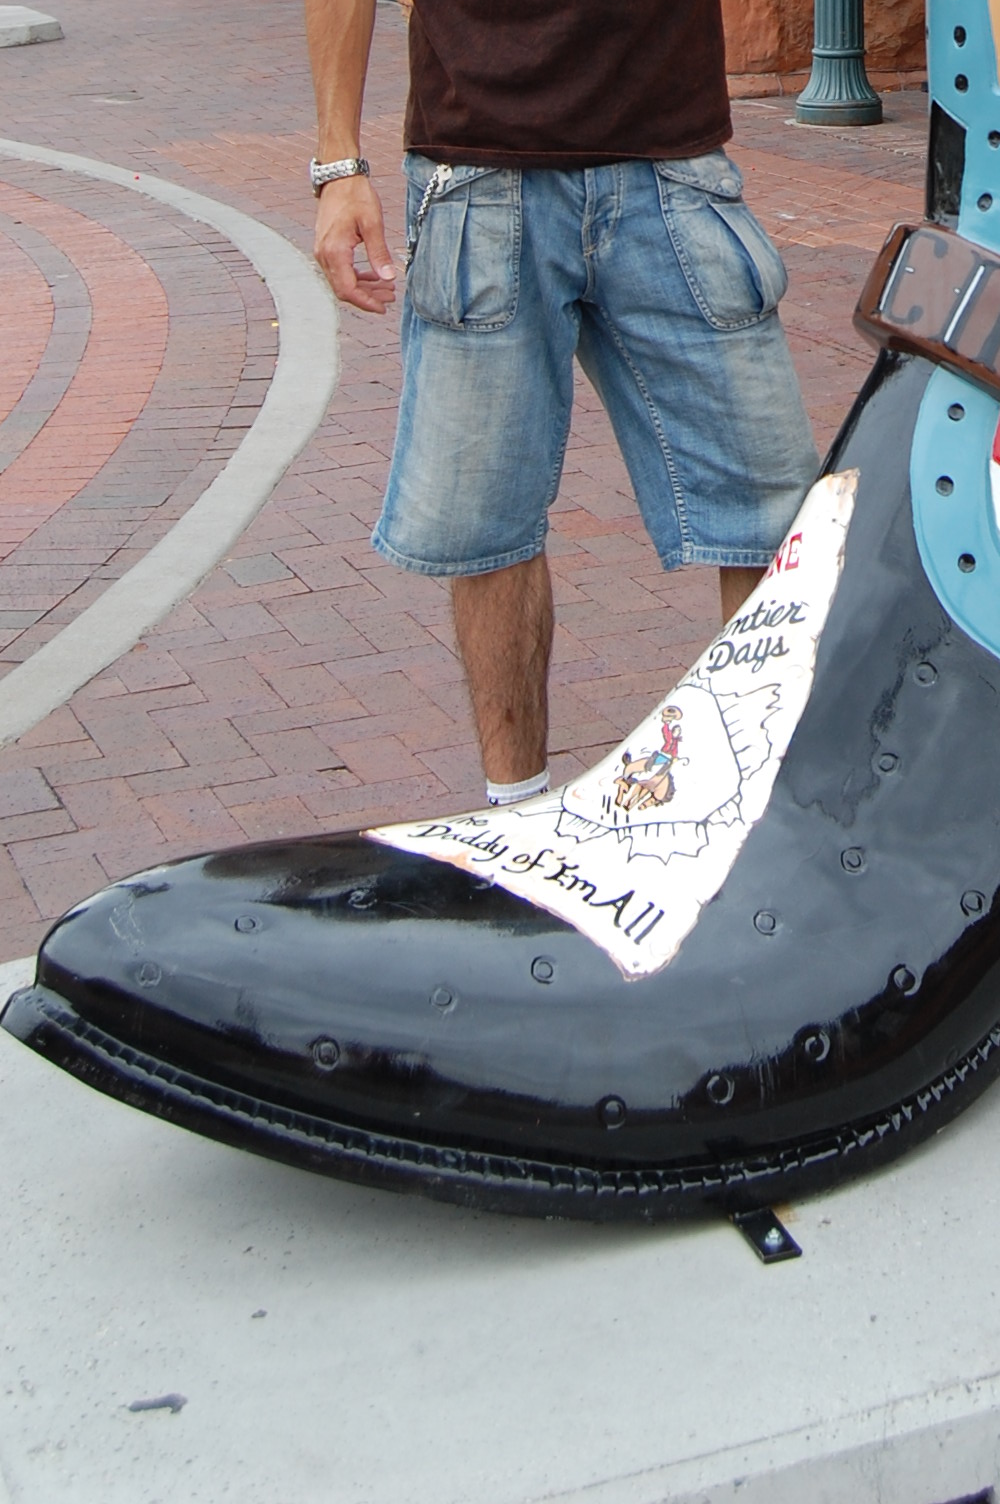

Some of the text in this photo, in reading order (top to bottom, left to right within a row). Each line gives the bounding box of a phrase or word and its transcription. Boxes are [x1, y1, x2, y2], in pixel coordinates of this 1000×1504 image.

[706, 635, 790, 674] Days
[407, 824, 509, 862] Daddy
[501, 849, 554, 874] of
[589, 889, 665, 945] All
